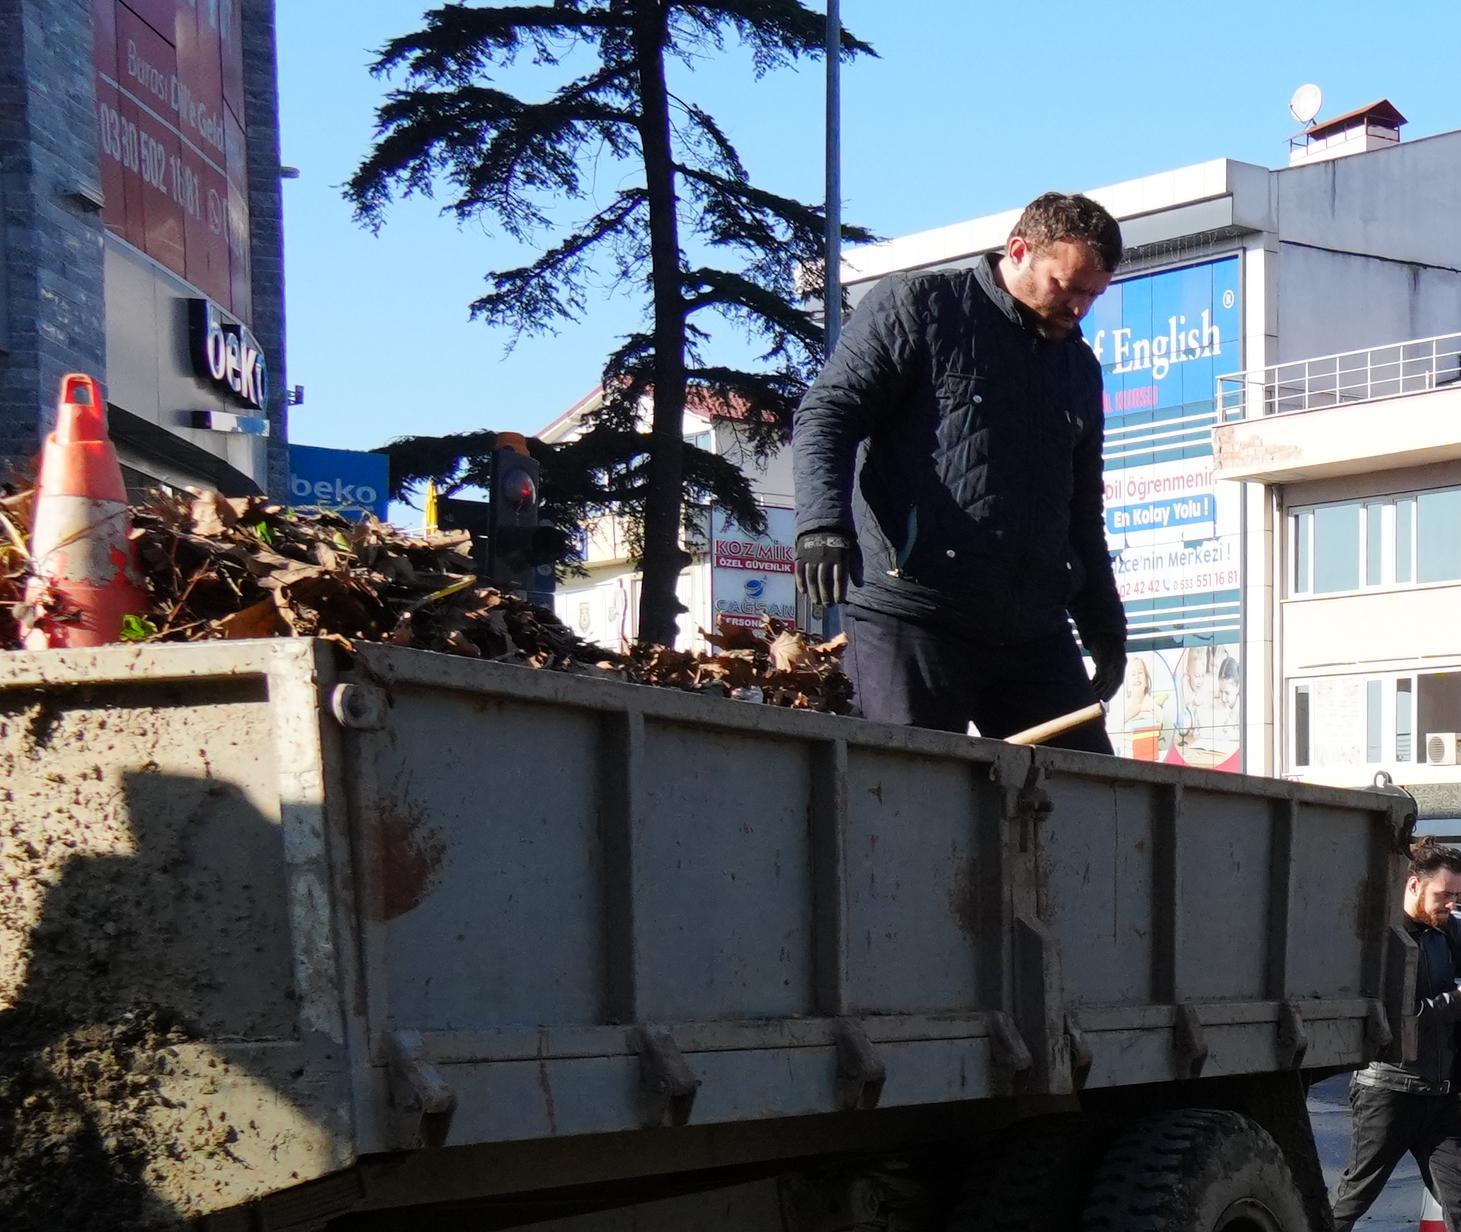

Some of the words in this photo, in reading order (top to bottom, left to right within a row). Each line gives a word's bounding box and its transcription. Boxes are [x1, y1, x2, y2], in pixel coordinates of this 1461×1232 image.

[1111, 308, 1222, 381] English
[291, 472, 377, 503] beko
[1105, 474, 1122, 500] Dil
[1114, 511, 1131, 529] En
[1133, 505, 1170, 527] Kolay
[1173, 499, 1202, 520] Yolu
[719, 559, 743, 569] ÖZEL
[1168, 543, 1223, 568] Merkezi
[1133, 581, 1145, 594] 42
[1148, 579, 1161, 593] 42
[1196, 573, 1213, 588] 551
[1214, 571, 1225, 586] 16
[1227, 570, 1238, 585] 81
